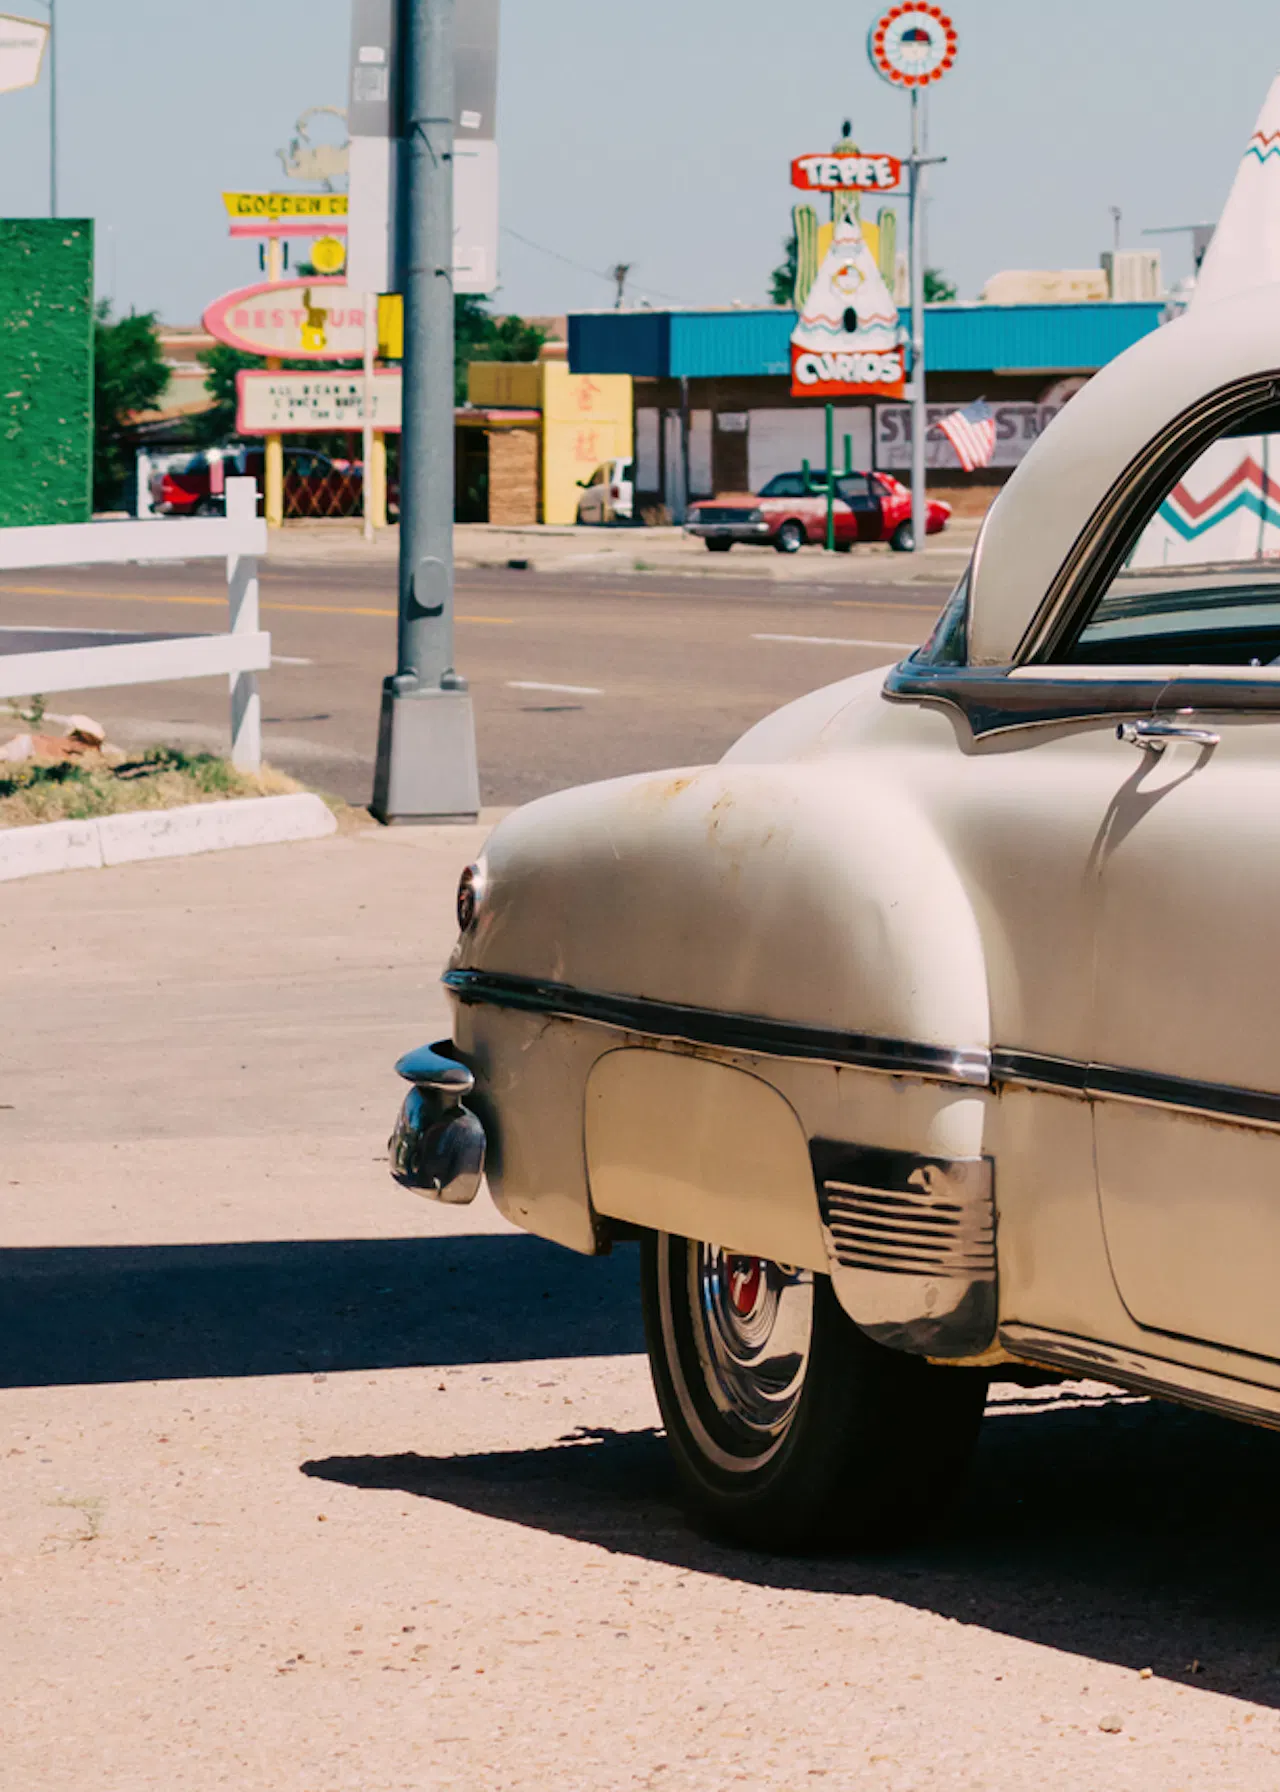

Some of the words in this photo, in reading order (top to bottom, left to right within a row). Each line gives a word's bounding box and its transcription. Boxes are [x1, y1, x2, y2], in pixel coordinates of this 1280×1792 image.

[798, 156, 896, 187] TEPEE
[237, 194, 321, 213] GOLDEN
[795, 352, 902, 385] CURIOS
